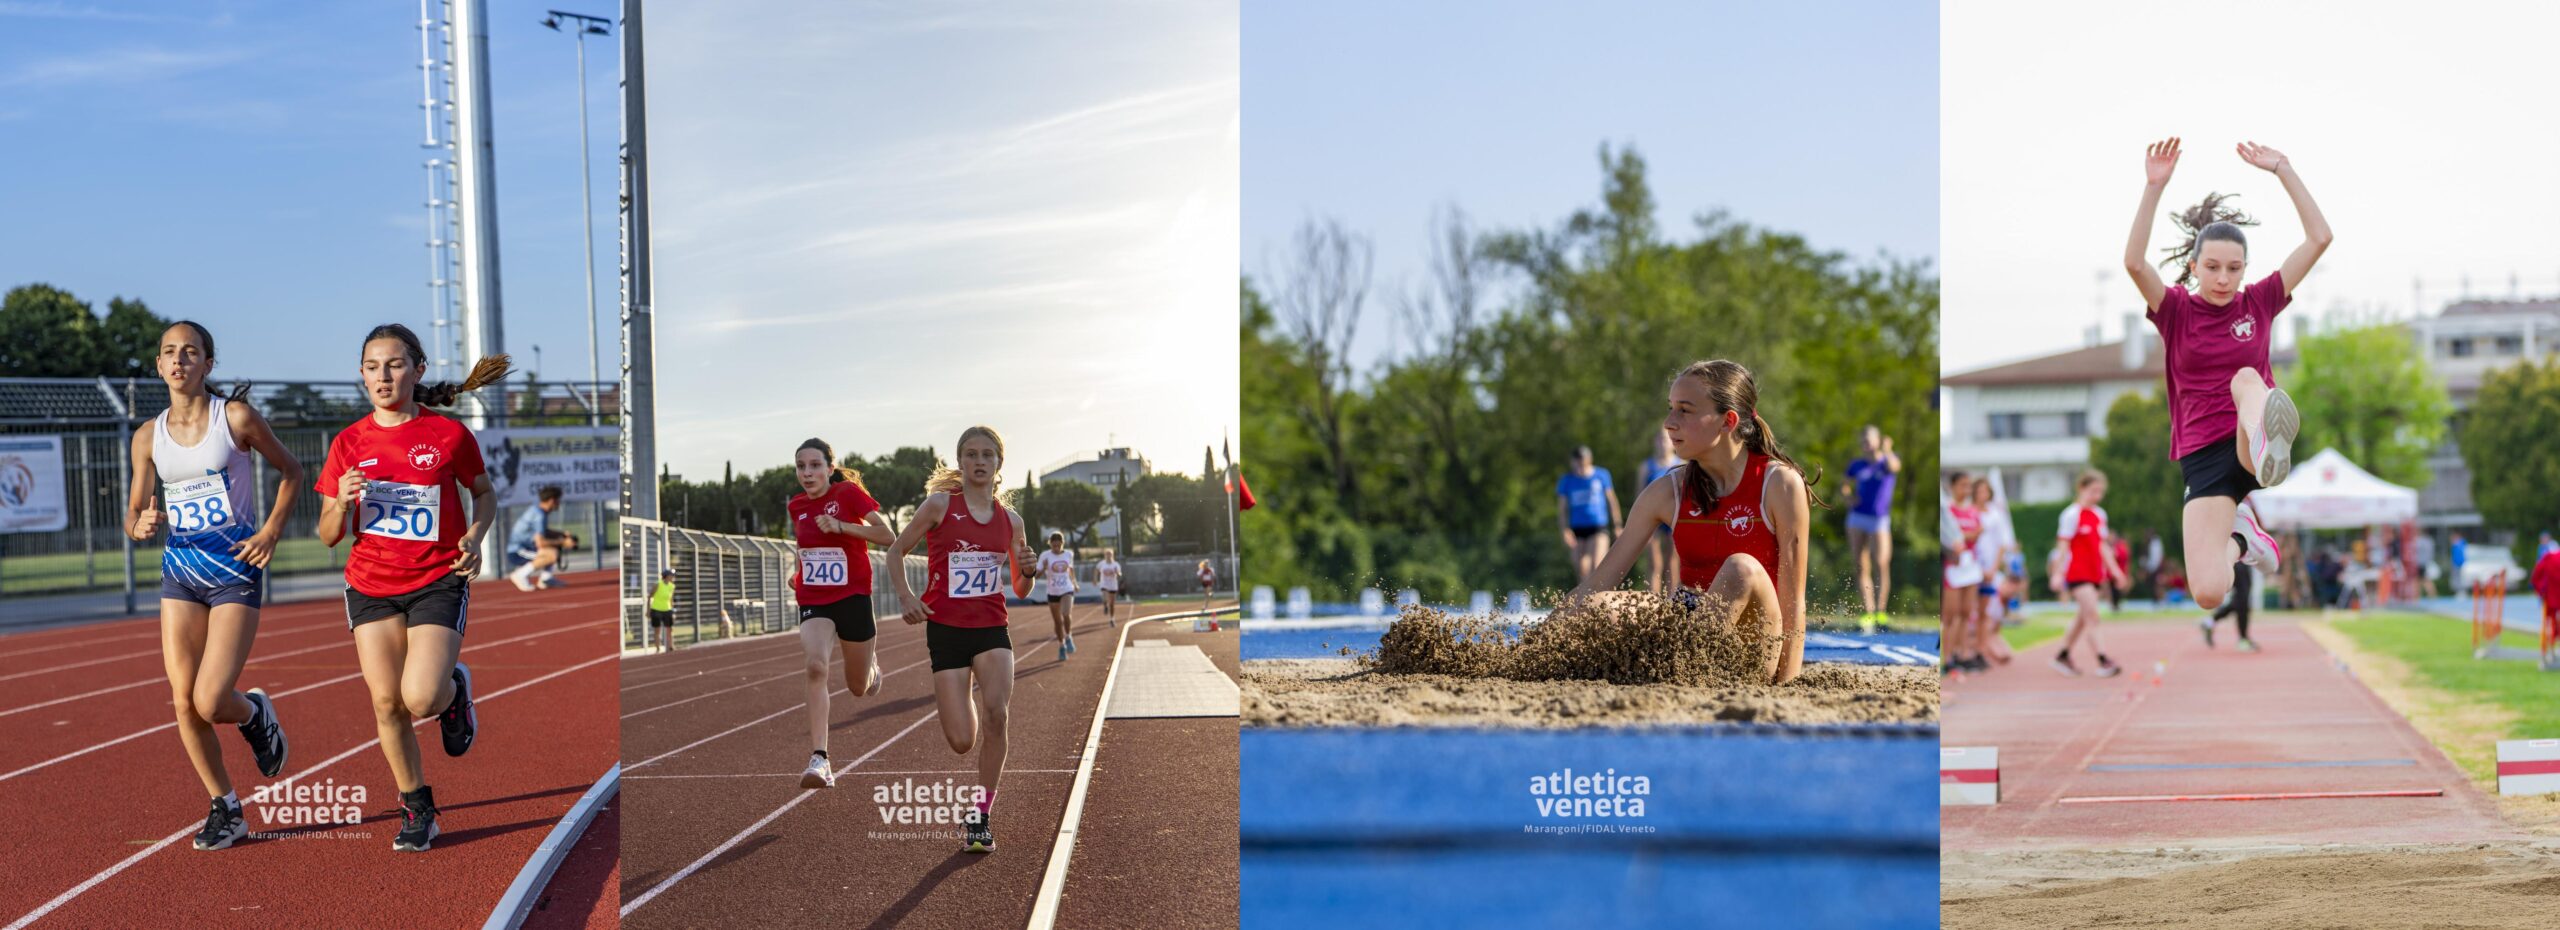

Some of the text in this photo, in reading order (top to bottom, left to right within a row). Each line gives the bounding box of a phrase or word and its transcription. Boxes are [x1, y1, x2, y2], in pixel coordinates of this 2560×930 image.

[522, 461, 563, 475] PISCINA
[183, 481, 212, 492] VENETA
[396, 489, 427, 498] VENETA
[169, 496, 228, 532] 238
[366, 502, 433, 537] 250
[805, 562, 844, 583] 240
[954, 567, 999, 595] 247
